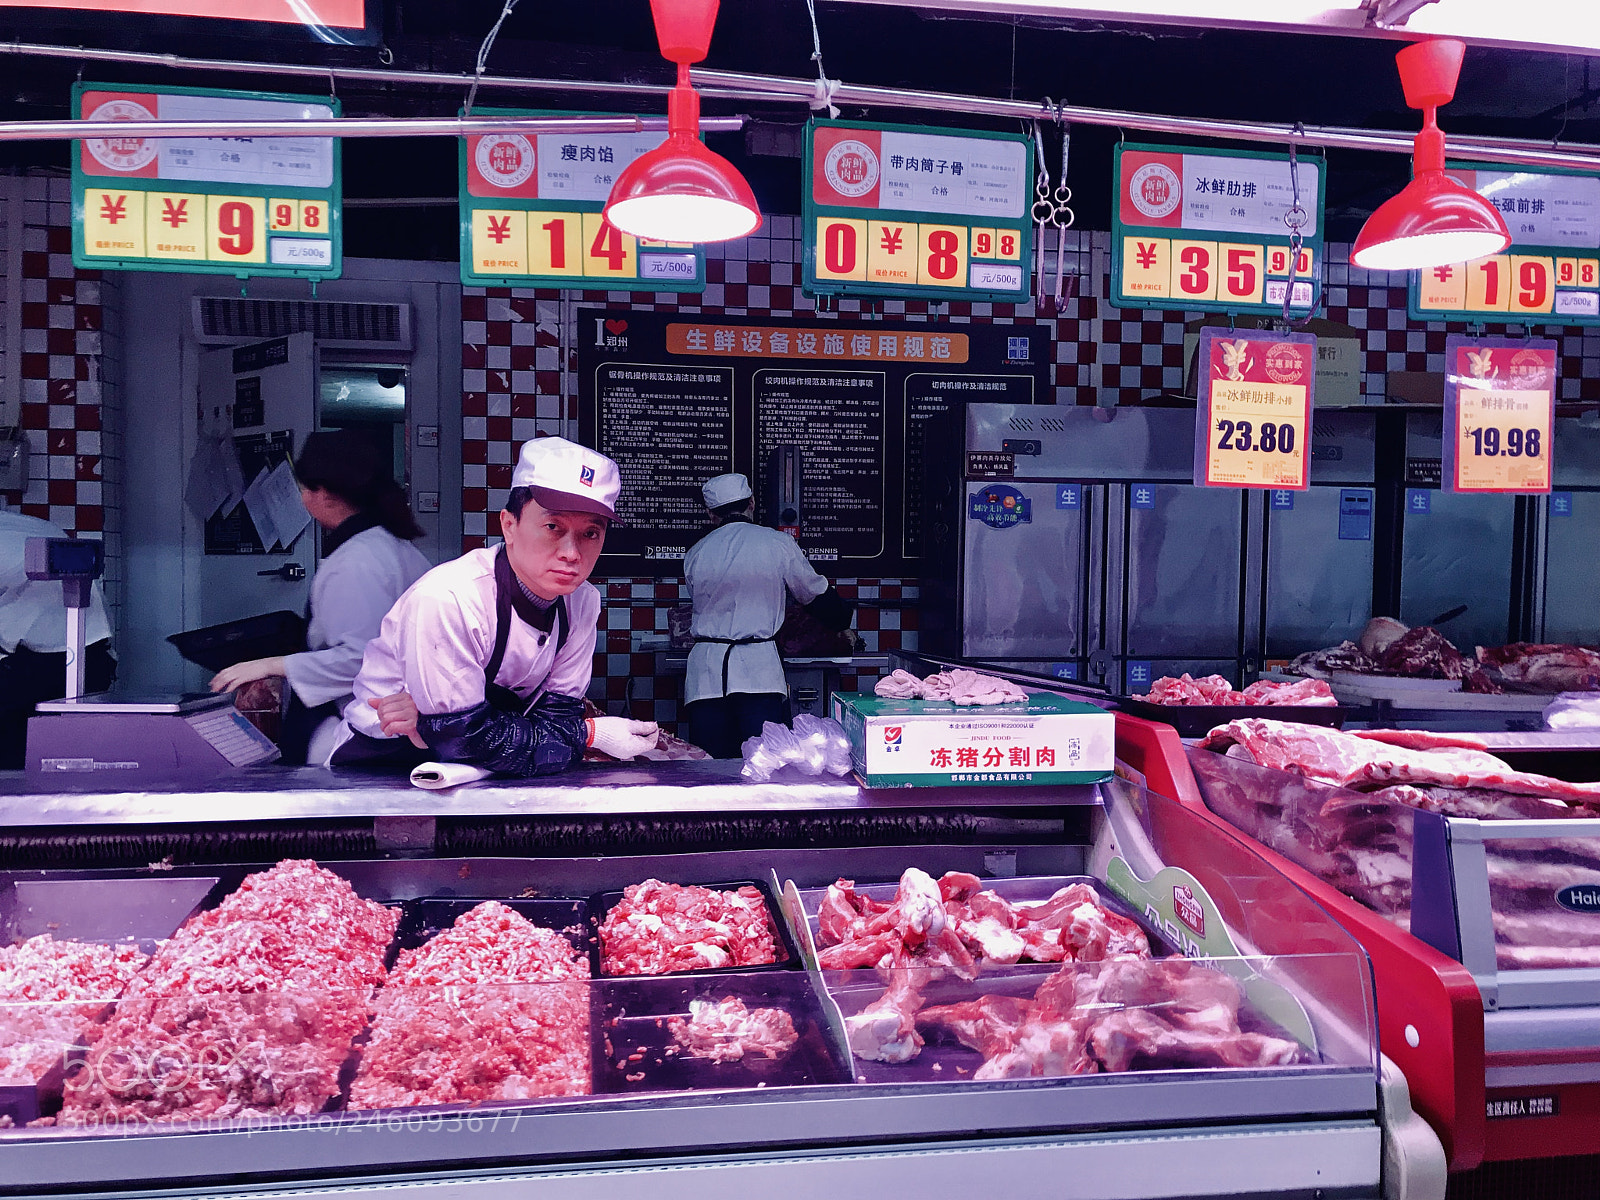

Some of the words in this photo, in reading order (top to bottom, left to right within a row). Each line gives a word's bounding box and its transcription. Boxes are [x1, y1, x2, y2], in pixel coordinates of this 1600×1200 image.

[560, 144, 614, 164] 瘦肉馅
[890, 154, 964, 176] 带肉筒子骨
[593, 174, 612, 185] 合格
[931, 185, 949, 197] 合格
[1195, 177, 1257, 199] 冰鲜肋排
[1229, 207, 1246, 217] 合格
[487, 215, 511, 244] ¥
[286, 246, 325, 259] 元/500g
[1136, 242, 1157, 269] ¥
[498, 260, 519, 268] PRICE
[651, 261, 693, 274] 元/500g
[889, 270, 908, 278] PRICE
[981, 273, 1017, 285] 元/500g
[1560, 297, 1592, 306] 元/500g
[606, 336, 628, 348] 郑州
[685, 329, 951, 360] 生鲜设备设施使用规范
[931, 380, 1008, 391] 切肉机操作及清洁规范
[1227, 388, 1276, 405] 冰鲜肋排
[1292, 450, 1300, 458] 元
[1061, 489, 1076, 505] 生
[1135, 488, 1151, 504] 生
[1411, 495, 1427, 510] 生
[1554, 497, 1569, 512] 生
[655, 545, 687, 553] DENNIS
[1131, 665, 1147, 682] 生
[929, 746, 1056, 768] 冻猪分割肉
[951, 773, 1033, 782] 邯郸市金都食品有限公司
[1570, 890, 1600, 905] Hai
